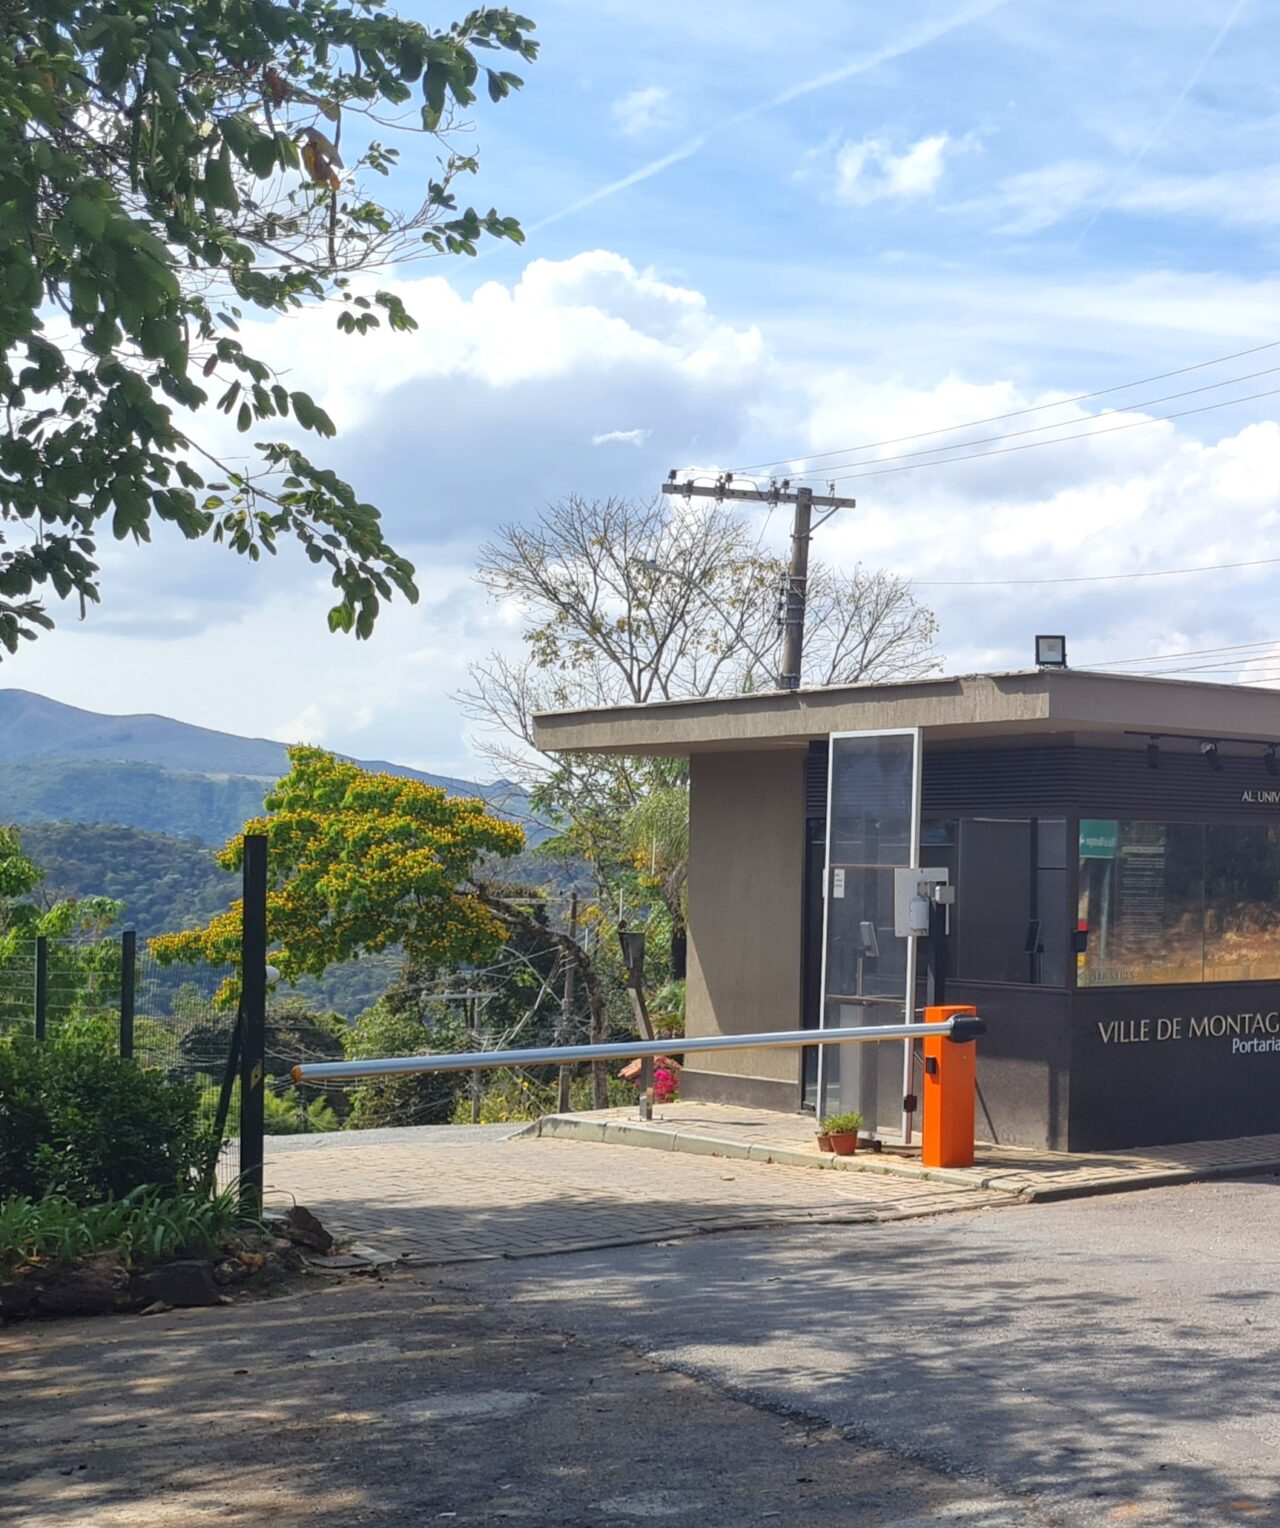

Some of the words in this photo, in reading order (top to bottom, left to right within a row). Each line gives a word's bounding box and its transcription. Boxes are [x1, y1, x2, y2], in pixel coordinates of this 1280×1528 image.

[1242, 791, 1255, 802] AL
[1098, 1019, 1150, 1044] VILLE
[1157, 1017, 1183, 1041] DE
